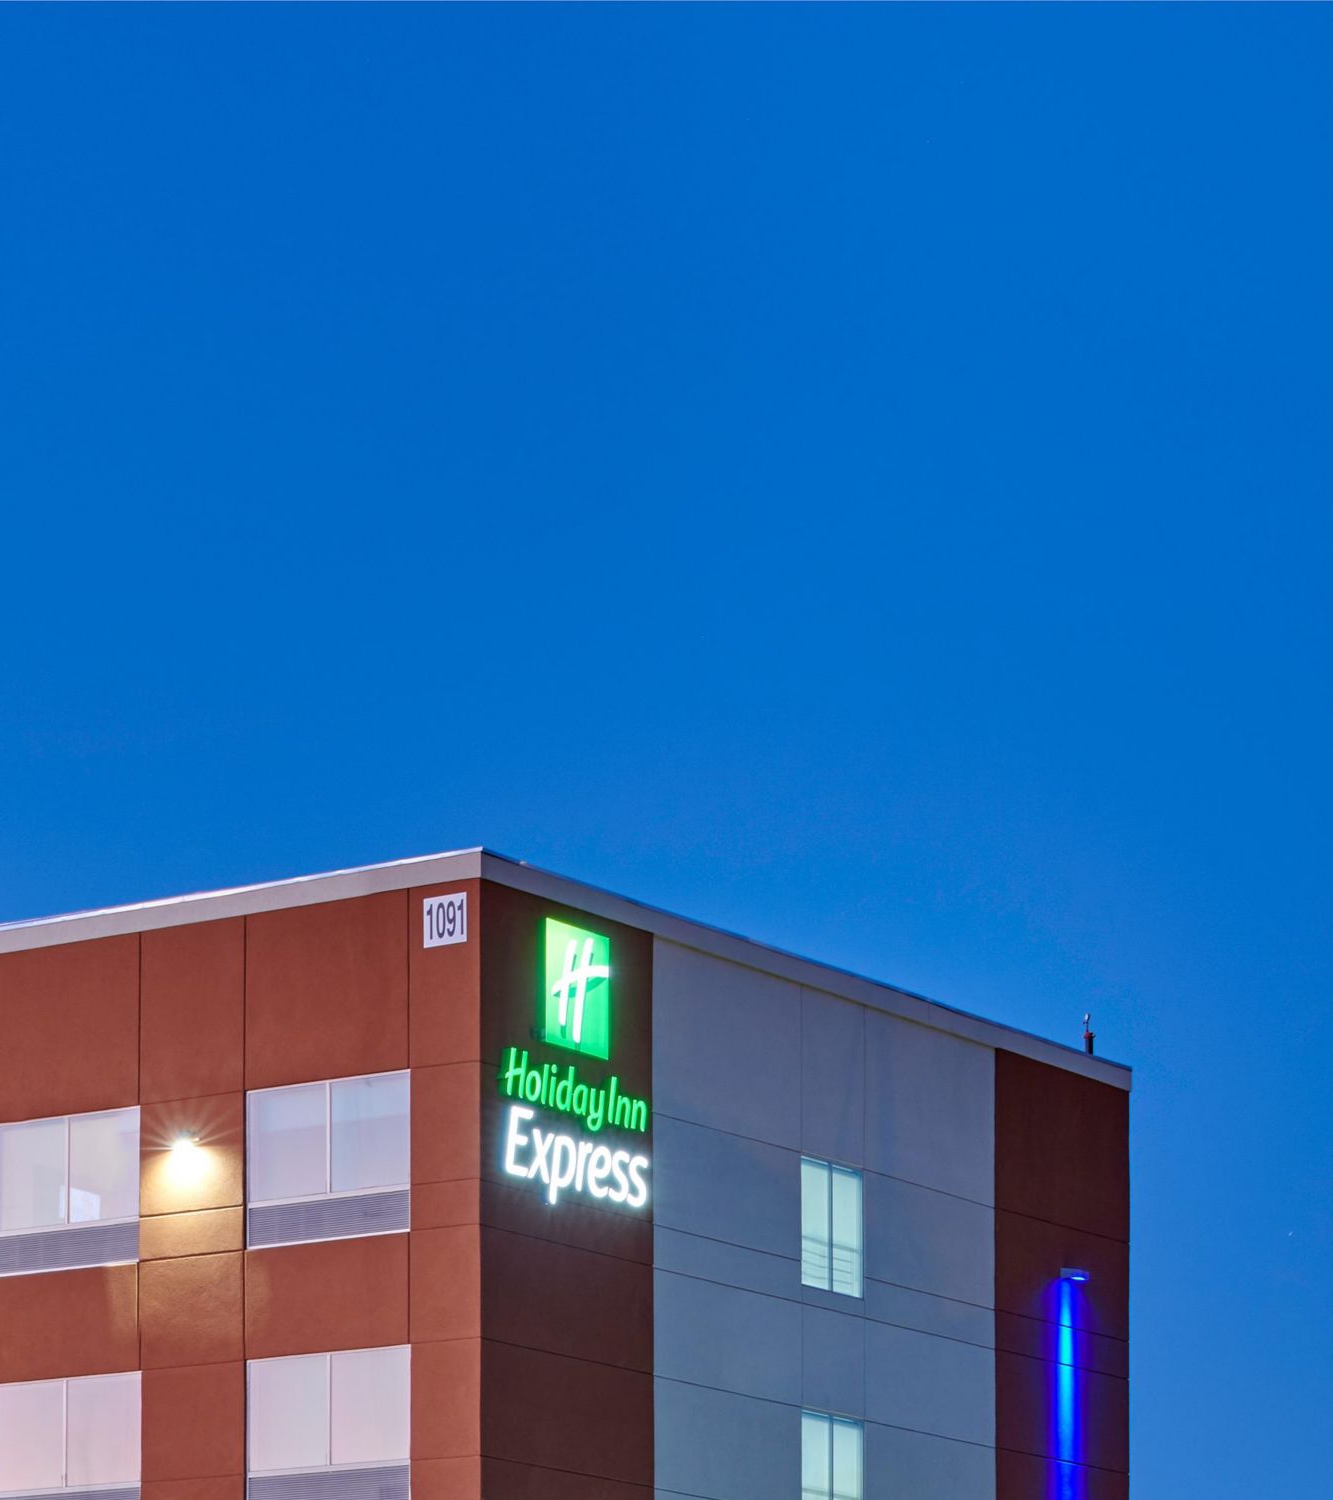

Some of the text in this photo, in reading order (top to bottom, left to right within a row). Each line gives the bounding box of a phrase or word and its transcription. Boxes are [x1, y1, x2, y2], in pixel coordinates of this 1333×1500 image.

[426, 898, 464, 940] 1091
[505, 1047, 647, 1133] Holiday Inn
[505, 1105, 649, 1208] Express
